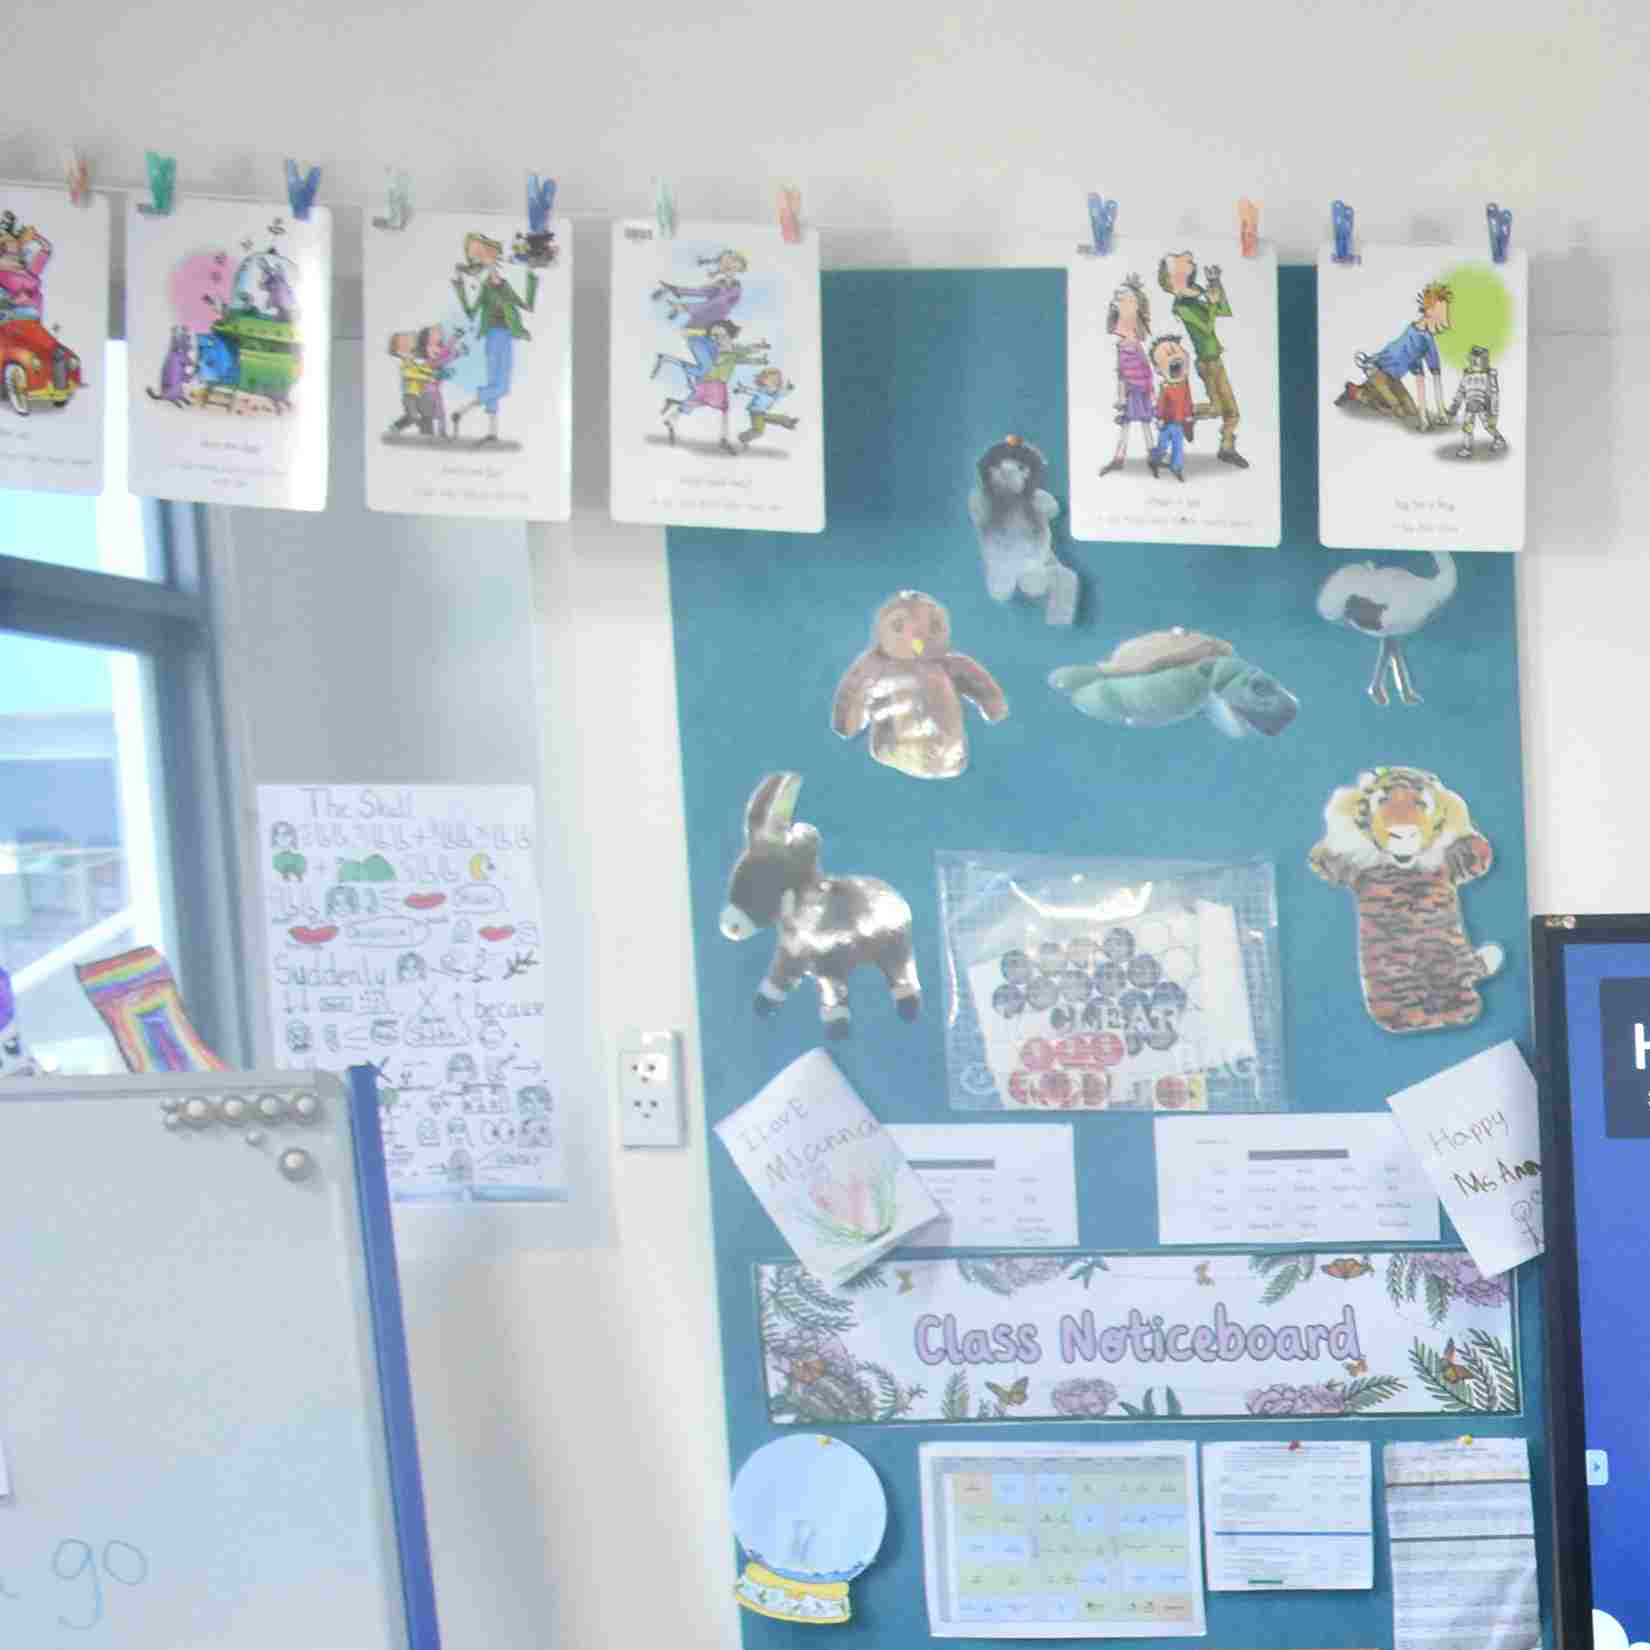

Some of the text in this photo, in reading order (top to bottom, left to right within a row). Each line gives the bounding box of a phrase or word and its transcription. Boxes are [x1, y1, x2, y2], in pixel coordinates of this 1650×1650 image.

[1427, 1109, 1510, 1157] Happy
[912, 1304, 1364, 1367] Class Noticeboard
